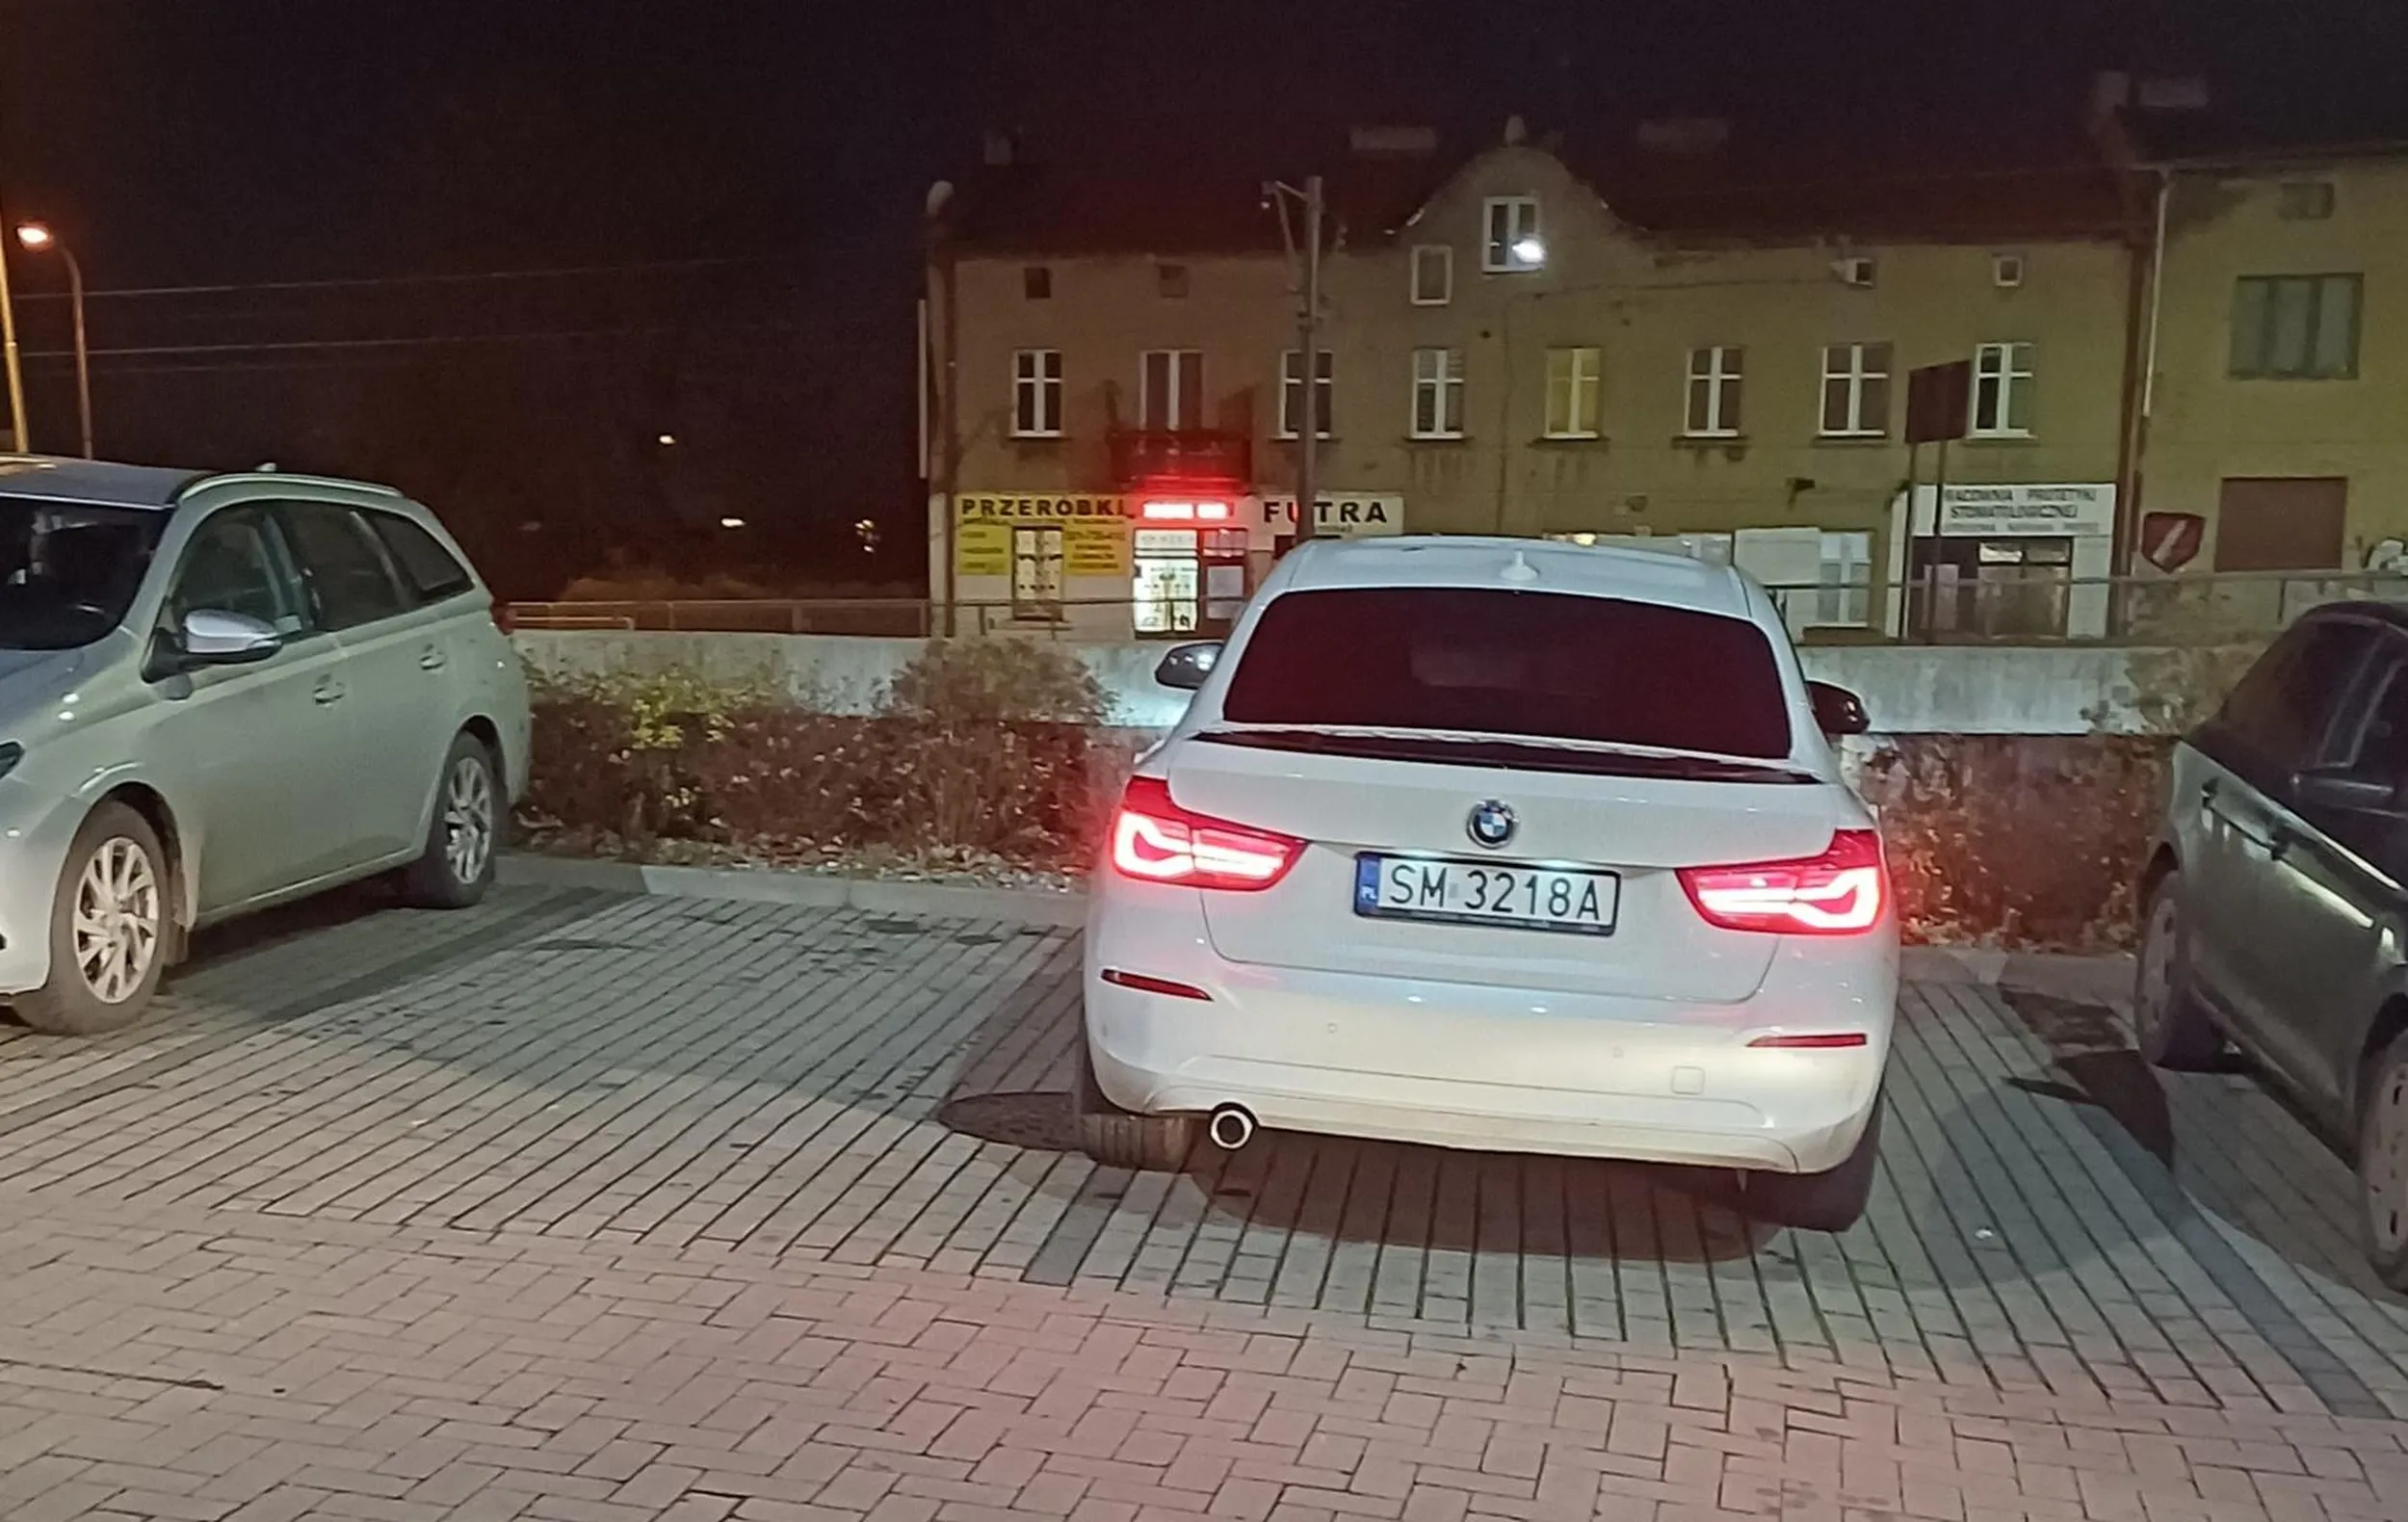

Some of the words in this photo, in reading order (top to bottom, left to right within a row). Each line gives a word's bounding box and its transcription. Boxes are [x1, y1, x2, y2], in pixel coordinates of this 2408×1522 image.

[1360, 887, 1378, 900] PL
[1389, 864, 1448, 907] SM
[1464, 869, 1601, 921] 3218A
